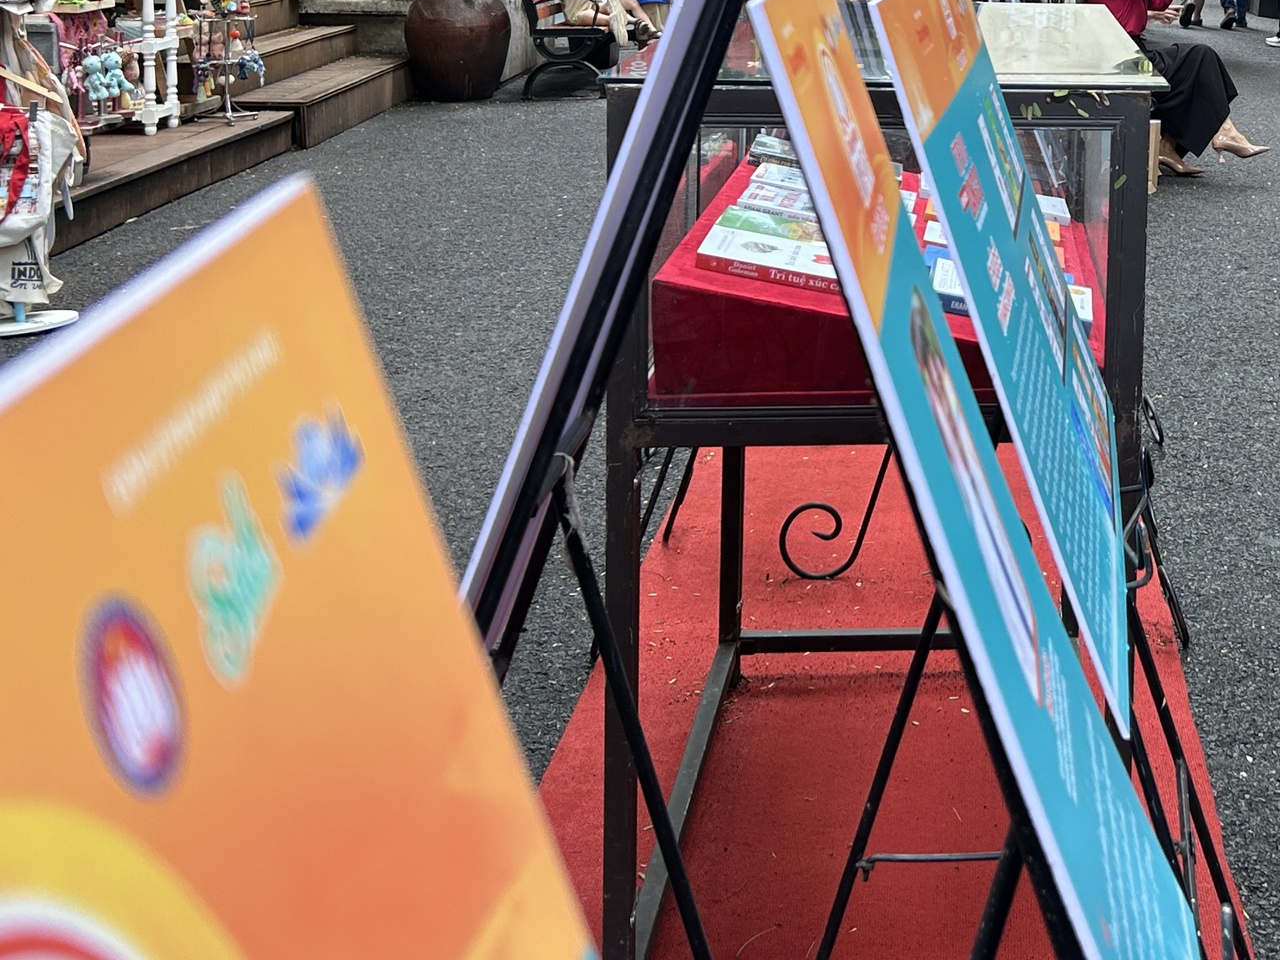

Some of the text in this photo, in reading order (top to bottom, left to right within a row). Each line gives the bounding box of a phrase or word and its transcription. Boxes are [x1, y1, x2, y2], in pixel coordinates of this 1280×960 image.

[762, 208, 784, 217] GRANT
[733, 260, 757, 271] Daniel
[728, 266, 759, 278] Goleman
[769, 268, 787, 281] Trí
[788, 273, 806, 286] tuệ
[808, 276, 828, 289] xúc
